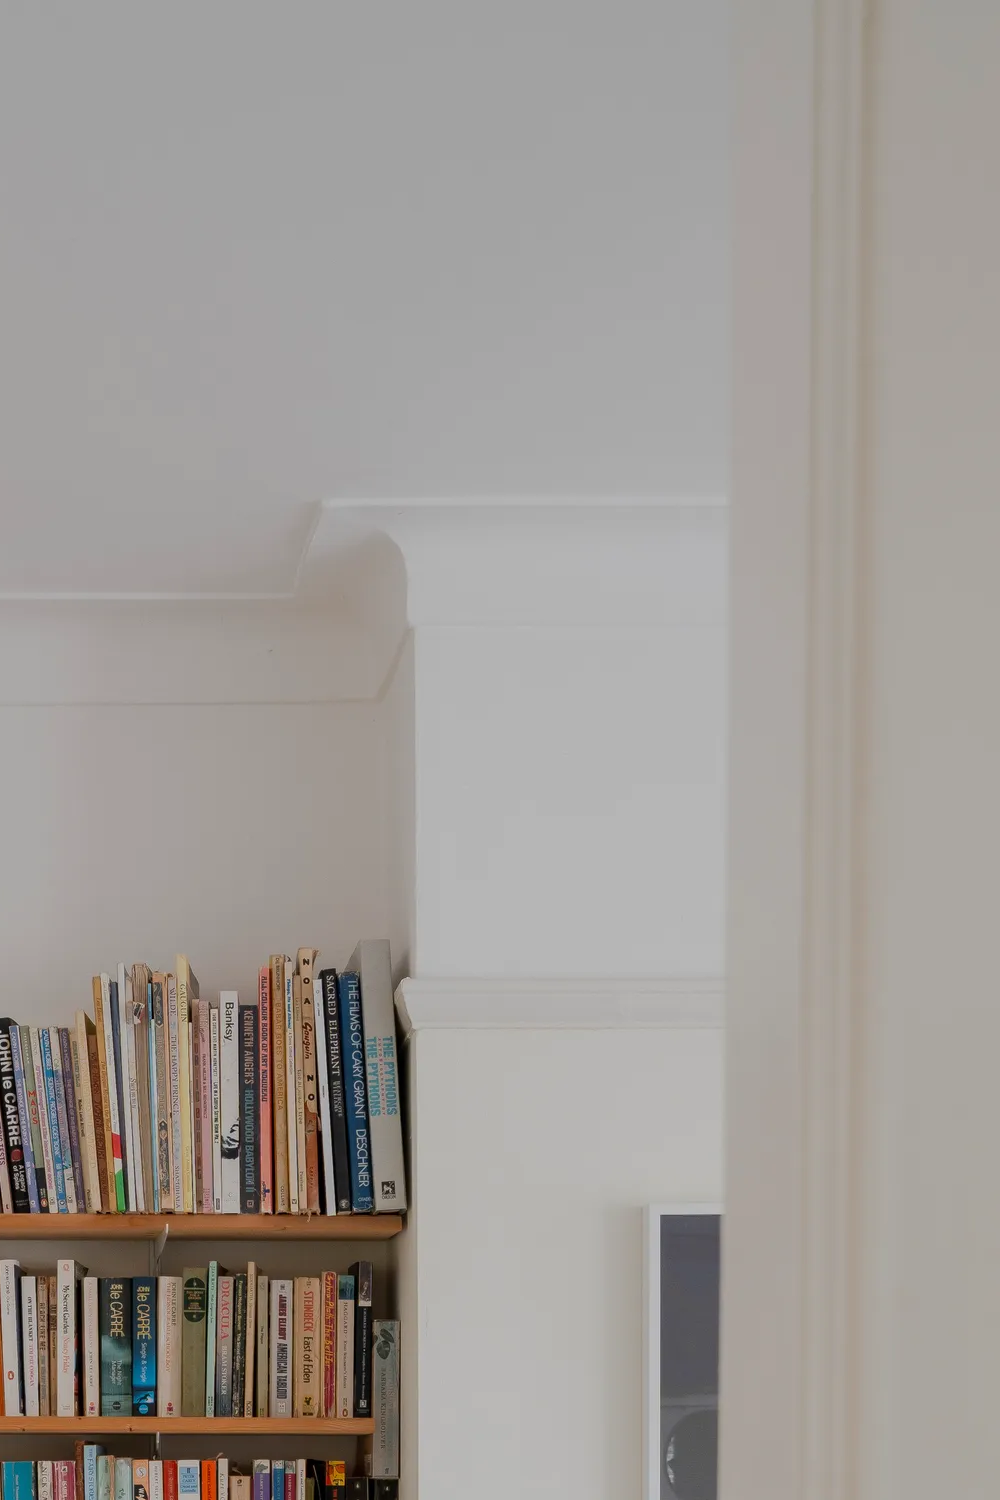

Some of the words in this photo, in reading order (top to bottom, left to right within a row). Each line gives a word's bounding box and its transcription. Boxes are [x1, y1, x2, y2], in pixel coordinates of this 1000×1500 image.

[347, 979, 359, 999] THE
[224, 1002, 235, 1041] Banksy
[244, 1010, 253, 1047] KENNETH
[349, 1001, 361, 1030] FILMS
[351, 1033, 362, 1048] OF
[366, 1037, 377, 1060] THE
[383, 1036, 393, 1058] THE
[245, 1050, 253, 1084] ANGER'S
[352, 1050, 363, 1078] CARY
[354, 1080, 365, 1119] GRANT
[369, 1062, 380, 1116] PYTHONS
[383, 1062, 397, 1115] PYTHONS
[245, 1090, 254, 1143] HOLLYWOOD
[245, 1146, 255, 1184] BABYLON
[355, 1129, 369, 1186] DESCHNER
[221, 1280, 233, 1340] DRACULA
[303, 1291, 313, 1331] STEINBECK
[304, 1354, 312, 1362] of
[304, 1364, 312, 1383] Eden
